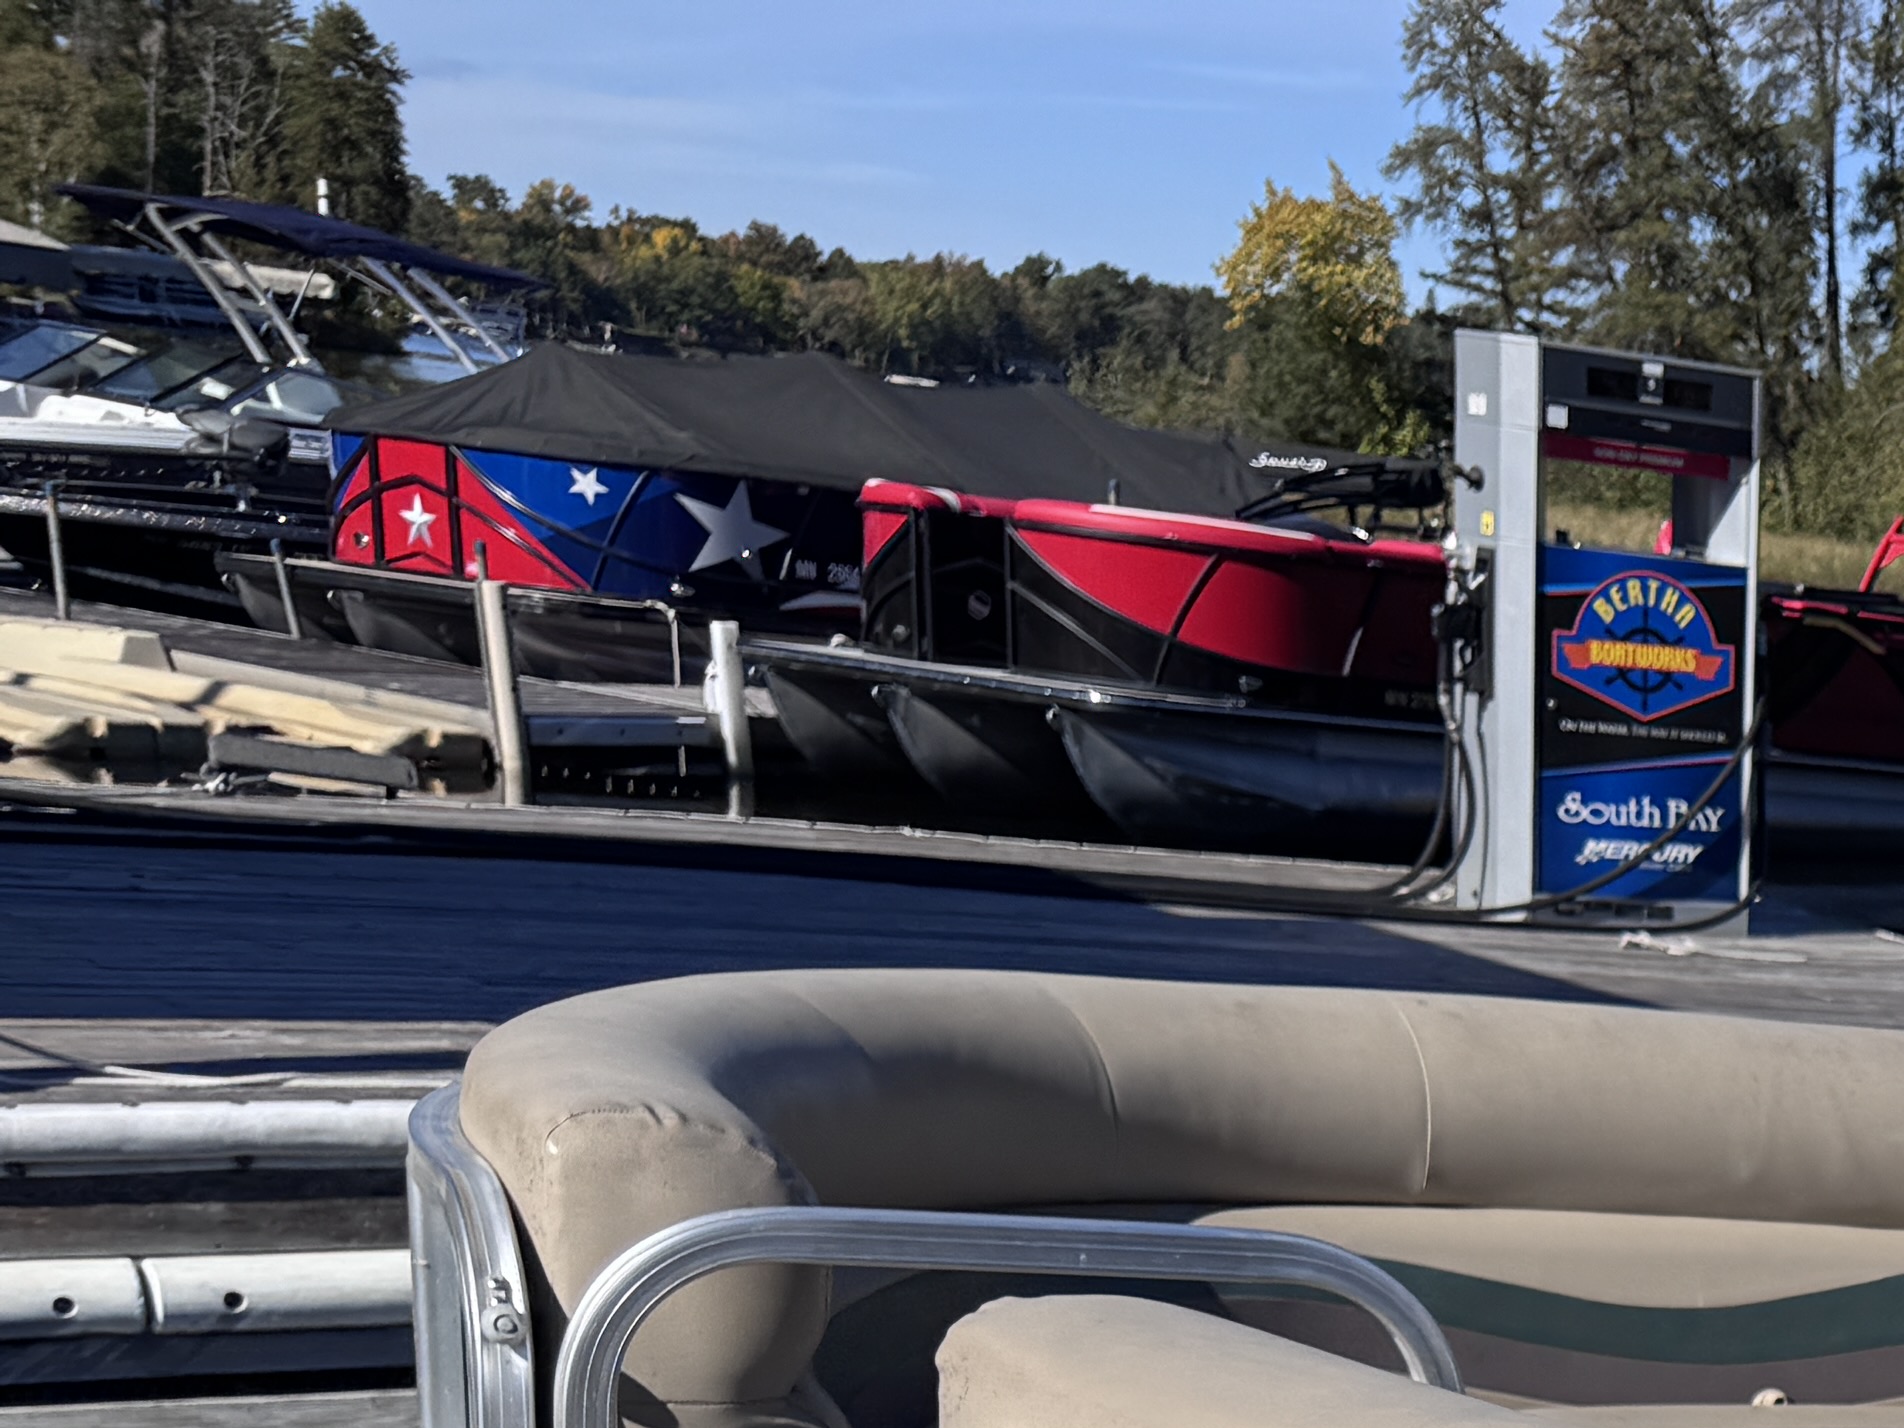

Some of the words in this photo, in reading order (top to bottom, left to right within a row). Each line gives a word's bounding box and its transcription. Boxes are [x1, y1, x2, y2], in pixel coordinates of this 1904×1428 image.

[1592, 577, 1697, 630] BERTHA
[1588, 639, 1698, 674] BOATWORKS
[1557, 791, 1663, 828] South
